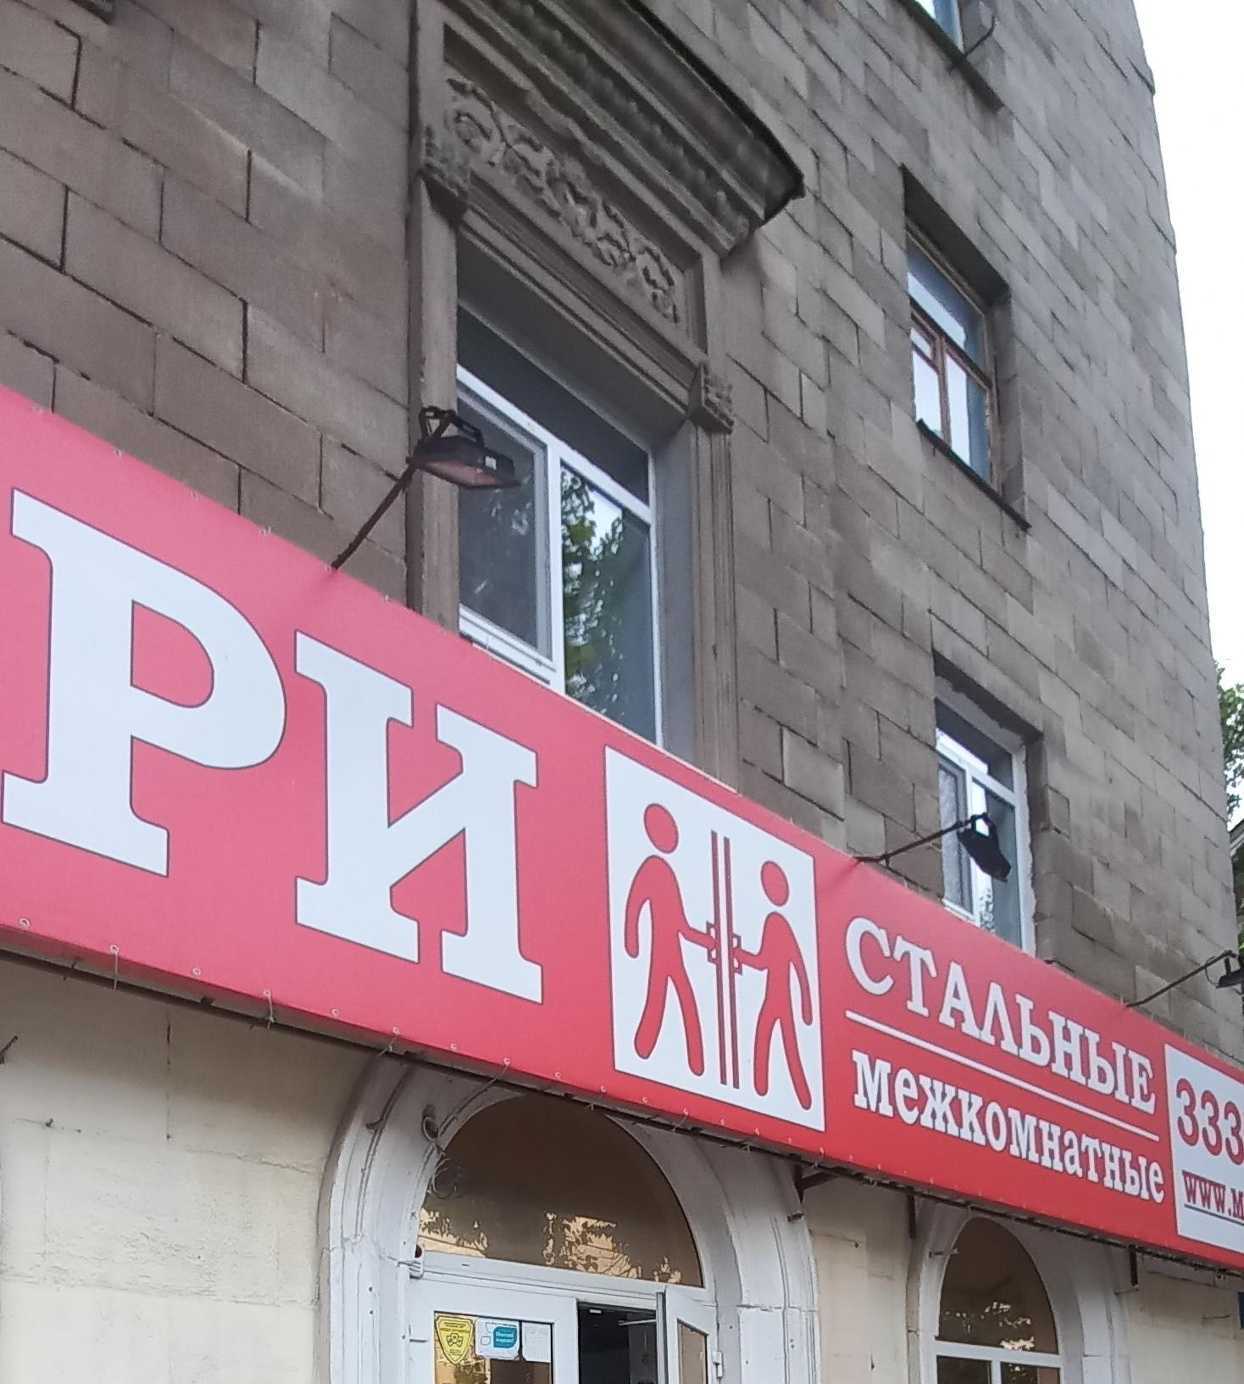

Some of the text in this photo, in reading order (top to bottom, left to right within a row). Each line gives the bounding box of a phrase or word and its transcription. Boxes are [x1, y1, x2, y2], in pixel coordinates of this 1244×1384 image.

[2, 488, 543, 1004] РИ
[845, 917, 1156, 1115] СТАЛЬНЫЕ
[852, 1049, 1166, 1203] межкомнатные
